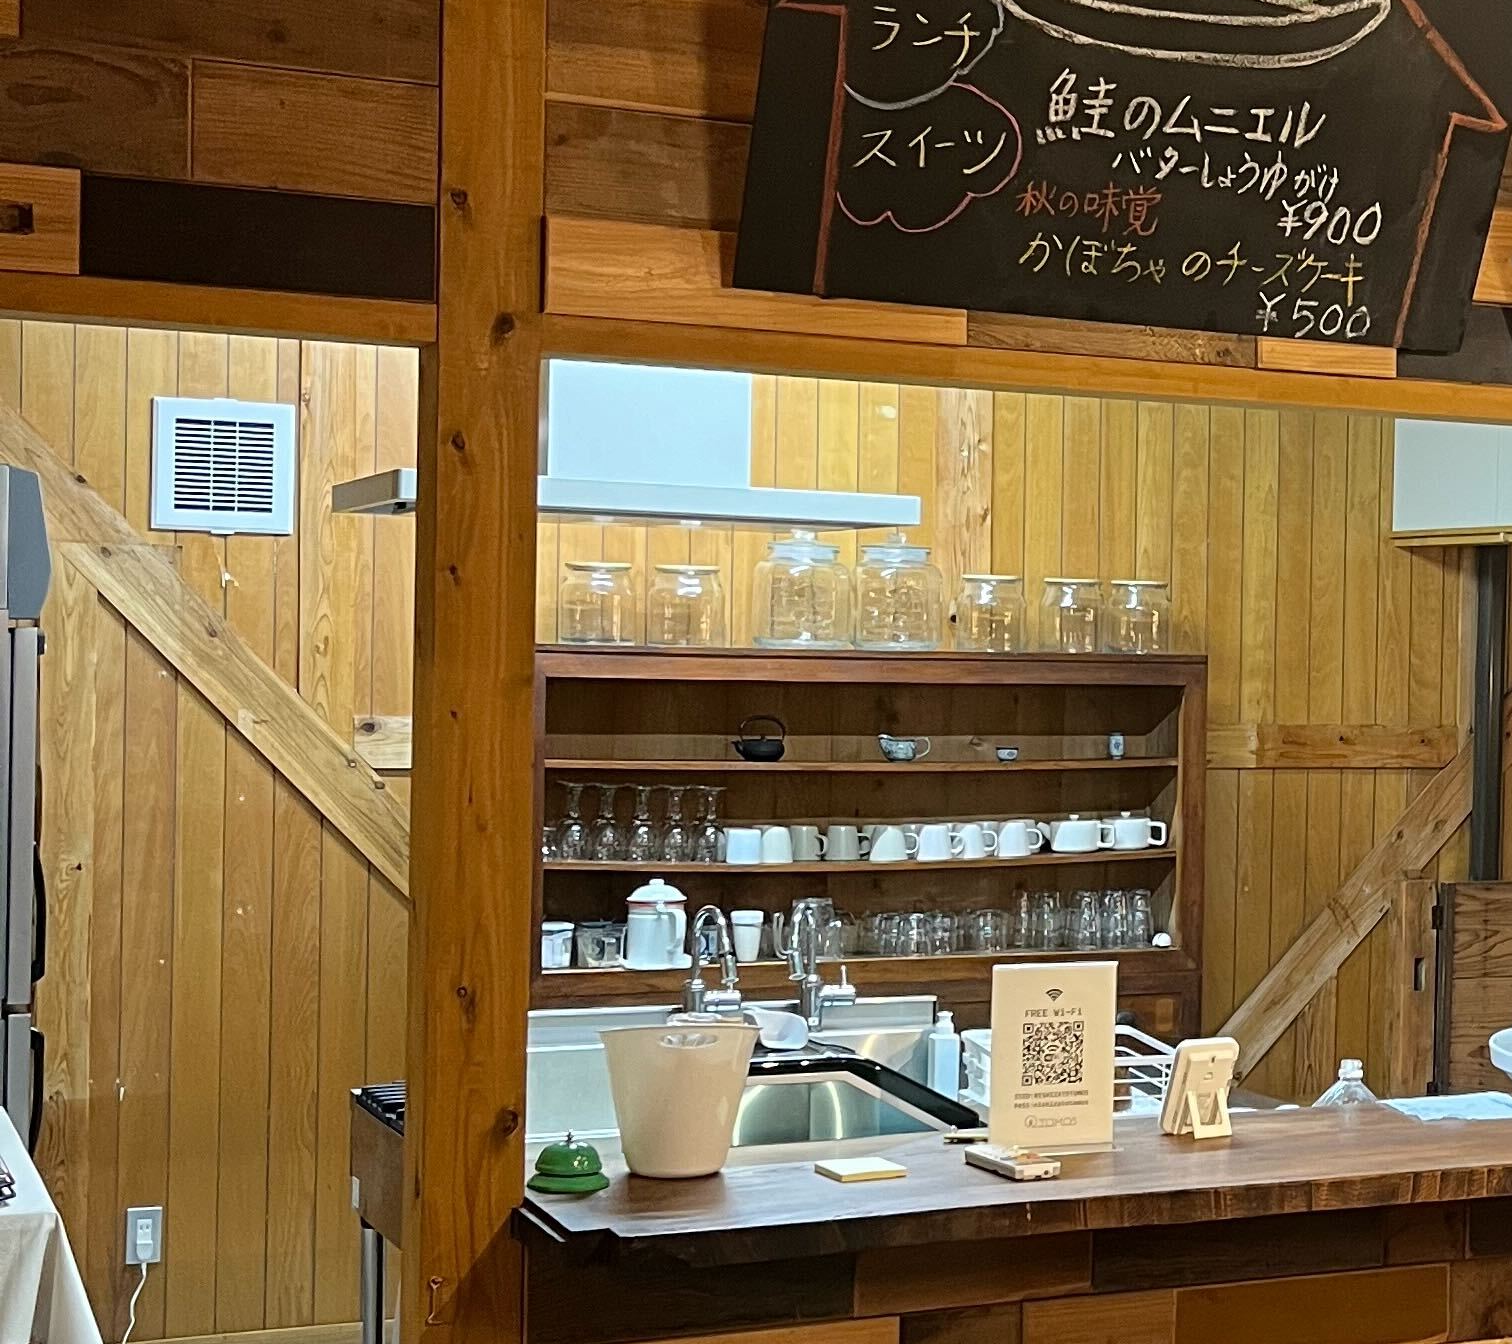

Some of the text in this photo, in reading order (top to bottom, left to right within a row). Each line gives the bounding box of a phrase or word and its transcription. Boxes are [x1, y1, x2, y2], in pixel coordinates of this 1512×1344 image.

[871, 5, 982, 63] ランチ
[1035, 67, 1328, 148] 鮭のムニエル
[851, 125, 1008, 176] スイーツ
[1015, 180, 1164, 237] 秋の味覚
[1276, 199, 1383, 246] ¥900
[1255, 291, 1372, 339] ¥500
[1024, 1007, 1083, 1019] FREE Wi-Fi
